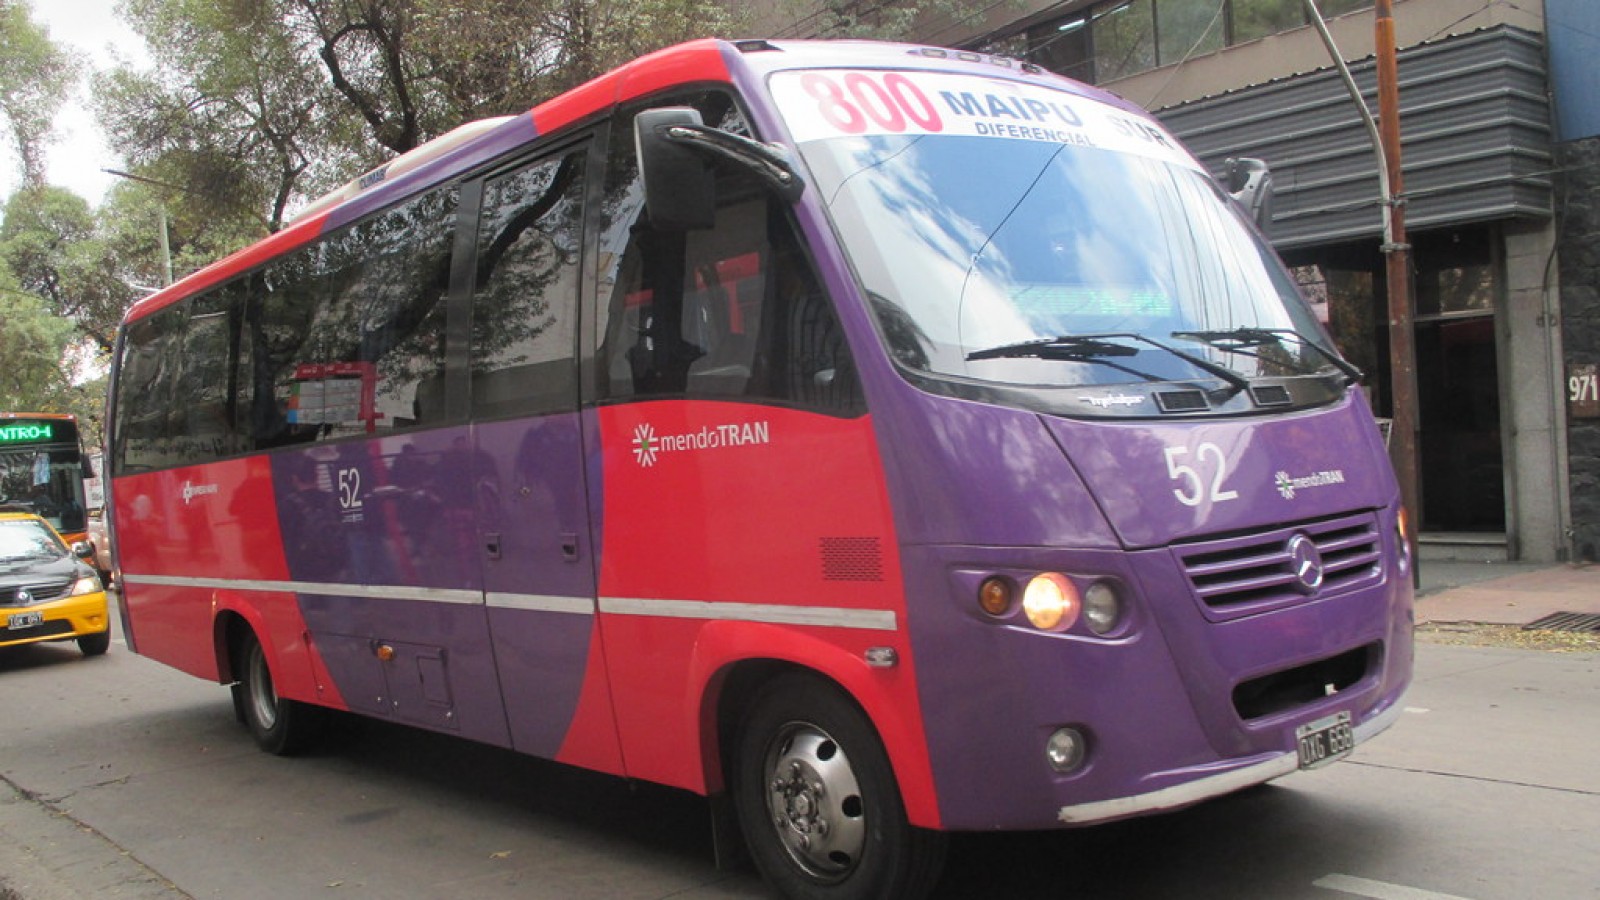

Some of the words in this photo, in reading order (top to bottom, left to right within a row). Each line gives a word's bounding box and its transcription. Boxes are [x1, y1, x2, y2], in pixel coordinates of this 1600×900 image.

[801, 73, 943, 133] 800
[939, 91, 1083, 127] MAIPU
[975, 121, 1095, 146] DIFERENCIAL
[1569, 375, 1598, 401] 971
[660, 421, 770, 452] mendoTRAN
[338, 467, 363, 509] 52
[1164, 442, 1239, 507] 52
